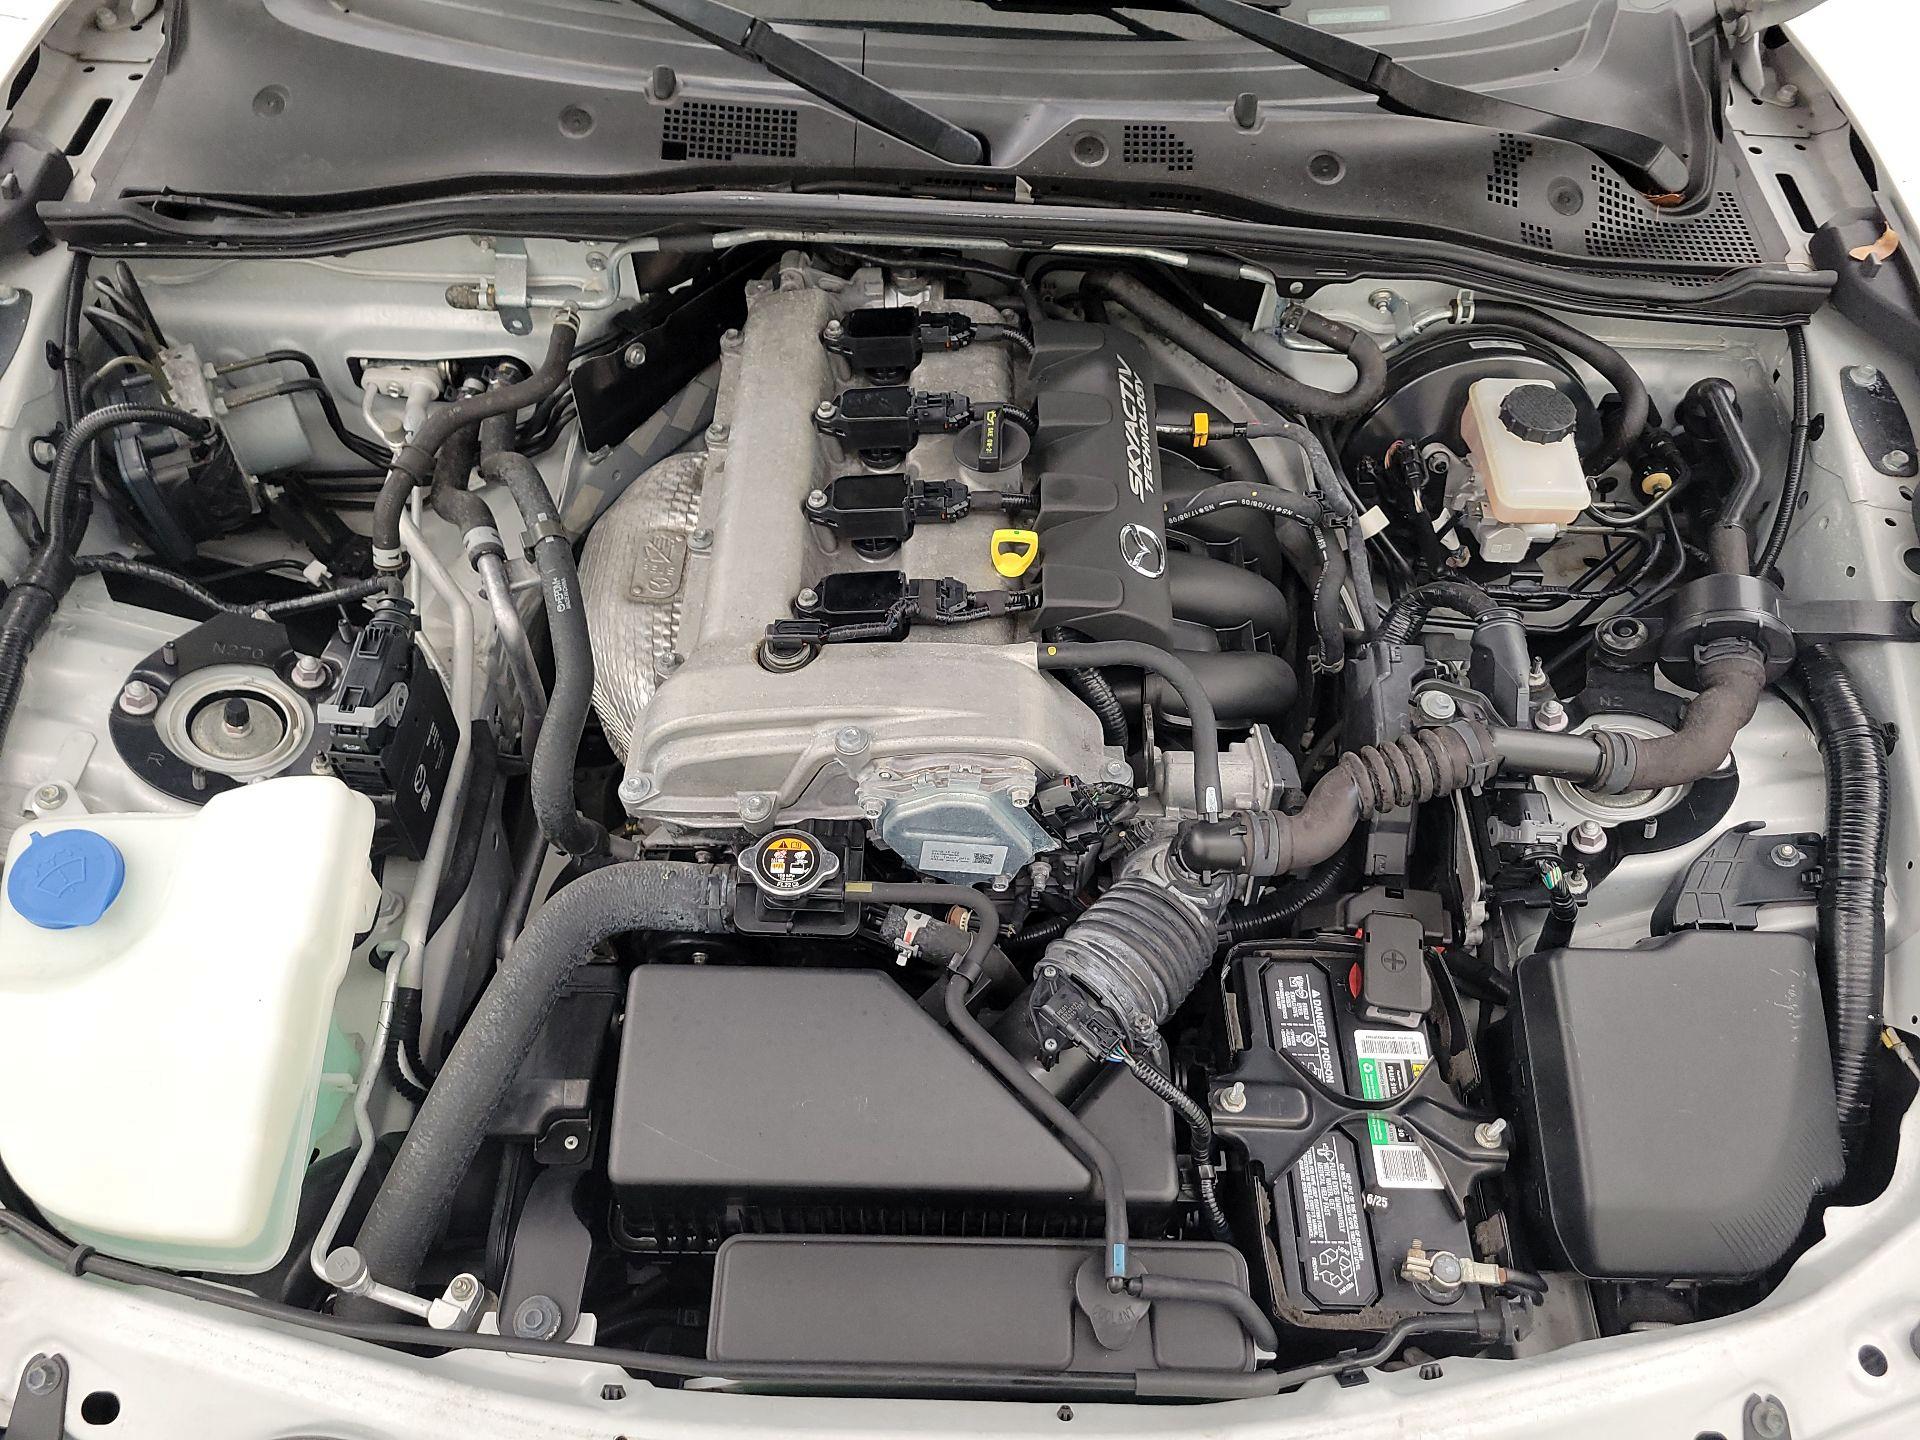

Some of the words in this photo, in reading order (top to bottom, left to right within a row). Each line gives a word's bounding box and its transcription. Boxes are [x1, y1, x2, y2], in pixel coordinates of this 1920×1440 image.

[1117, 354, 1145, 503] SKYACTIV
[1134, 372, 1153, 494] TECHNOLOGY
[1313, 999, 1327, 1038] DANGER
[1321, 1046, 1334, 1084] POISON
[1387, 1065, 1395, 1082] PLUS
[1317, 1162, 1325, 1185] MEDICAL
[1330, 1162, 1338, 1180] FLUSH
[1320, 1186, 1328, 1201] HELP
[1332, 1180, 1340, 1195] EYES
[1366, 1193, 1388, 1208] 6/25
[1334, 1196, 1346, 1234] IMMEDIATELY
[1311, 1257, 1319, 1281] RECYCLE
